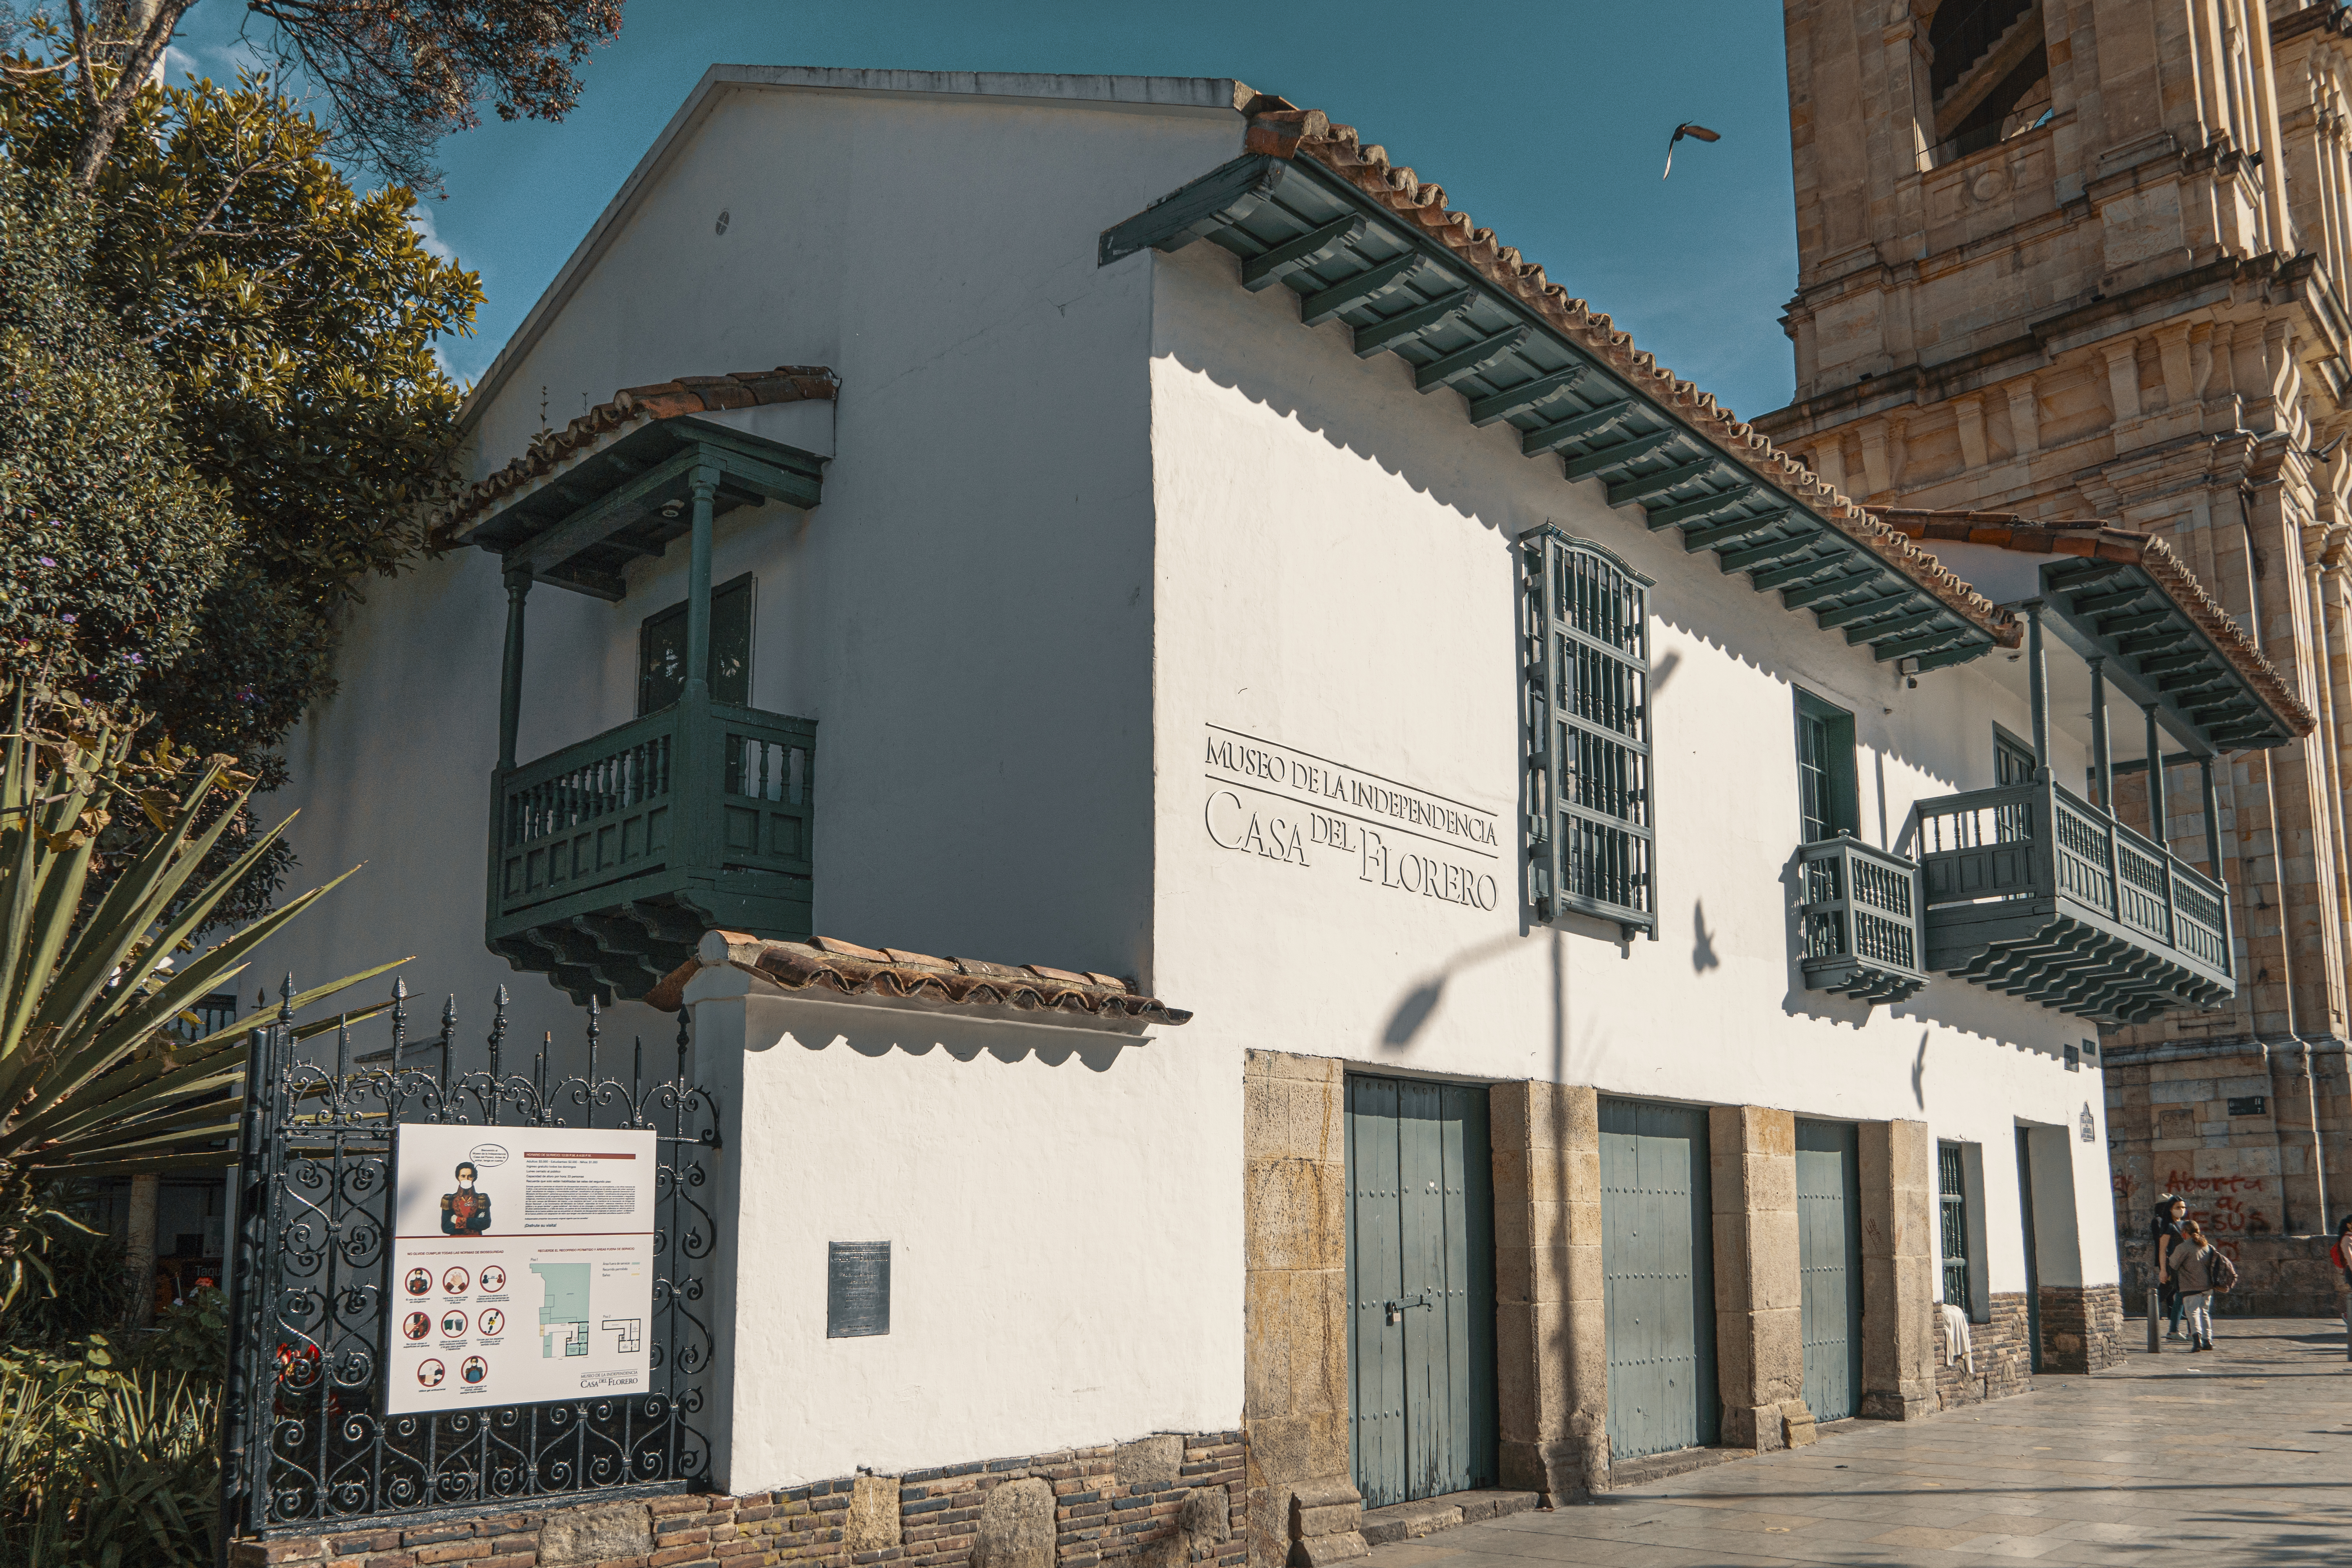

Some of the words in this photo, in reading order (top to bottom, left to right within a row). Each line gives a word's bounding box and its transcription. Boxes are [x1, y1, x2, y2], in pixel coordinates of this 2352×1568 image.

[1205, 737, 1285, 782] MUSEO
[1292, 761, 1319, 794] DE
[1324, 770, 1347, 802] LA
[1351, 780, 1498, 846] INDEPENDENCIA
[1205, 789, 1310, 867] CASA
[1310, 813, 1356, 852] DEL
[1359, 827, 1499, 911] FLORERO
[2165, 1170, 2263, 1192] Aborta
[832, 1254, 850, 1262] CASA
[860, 1253, 889, 1261] FLORERO
